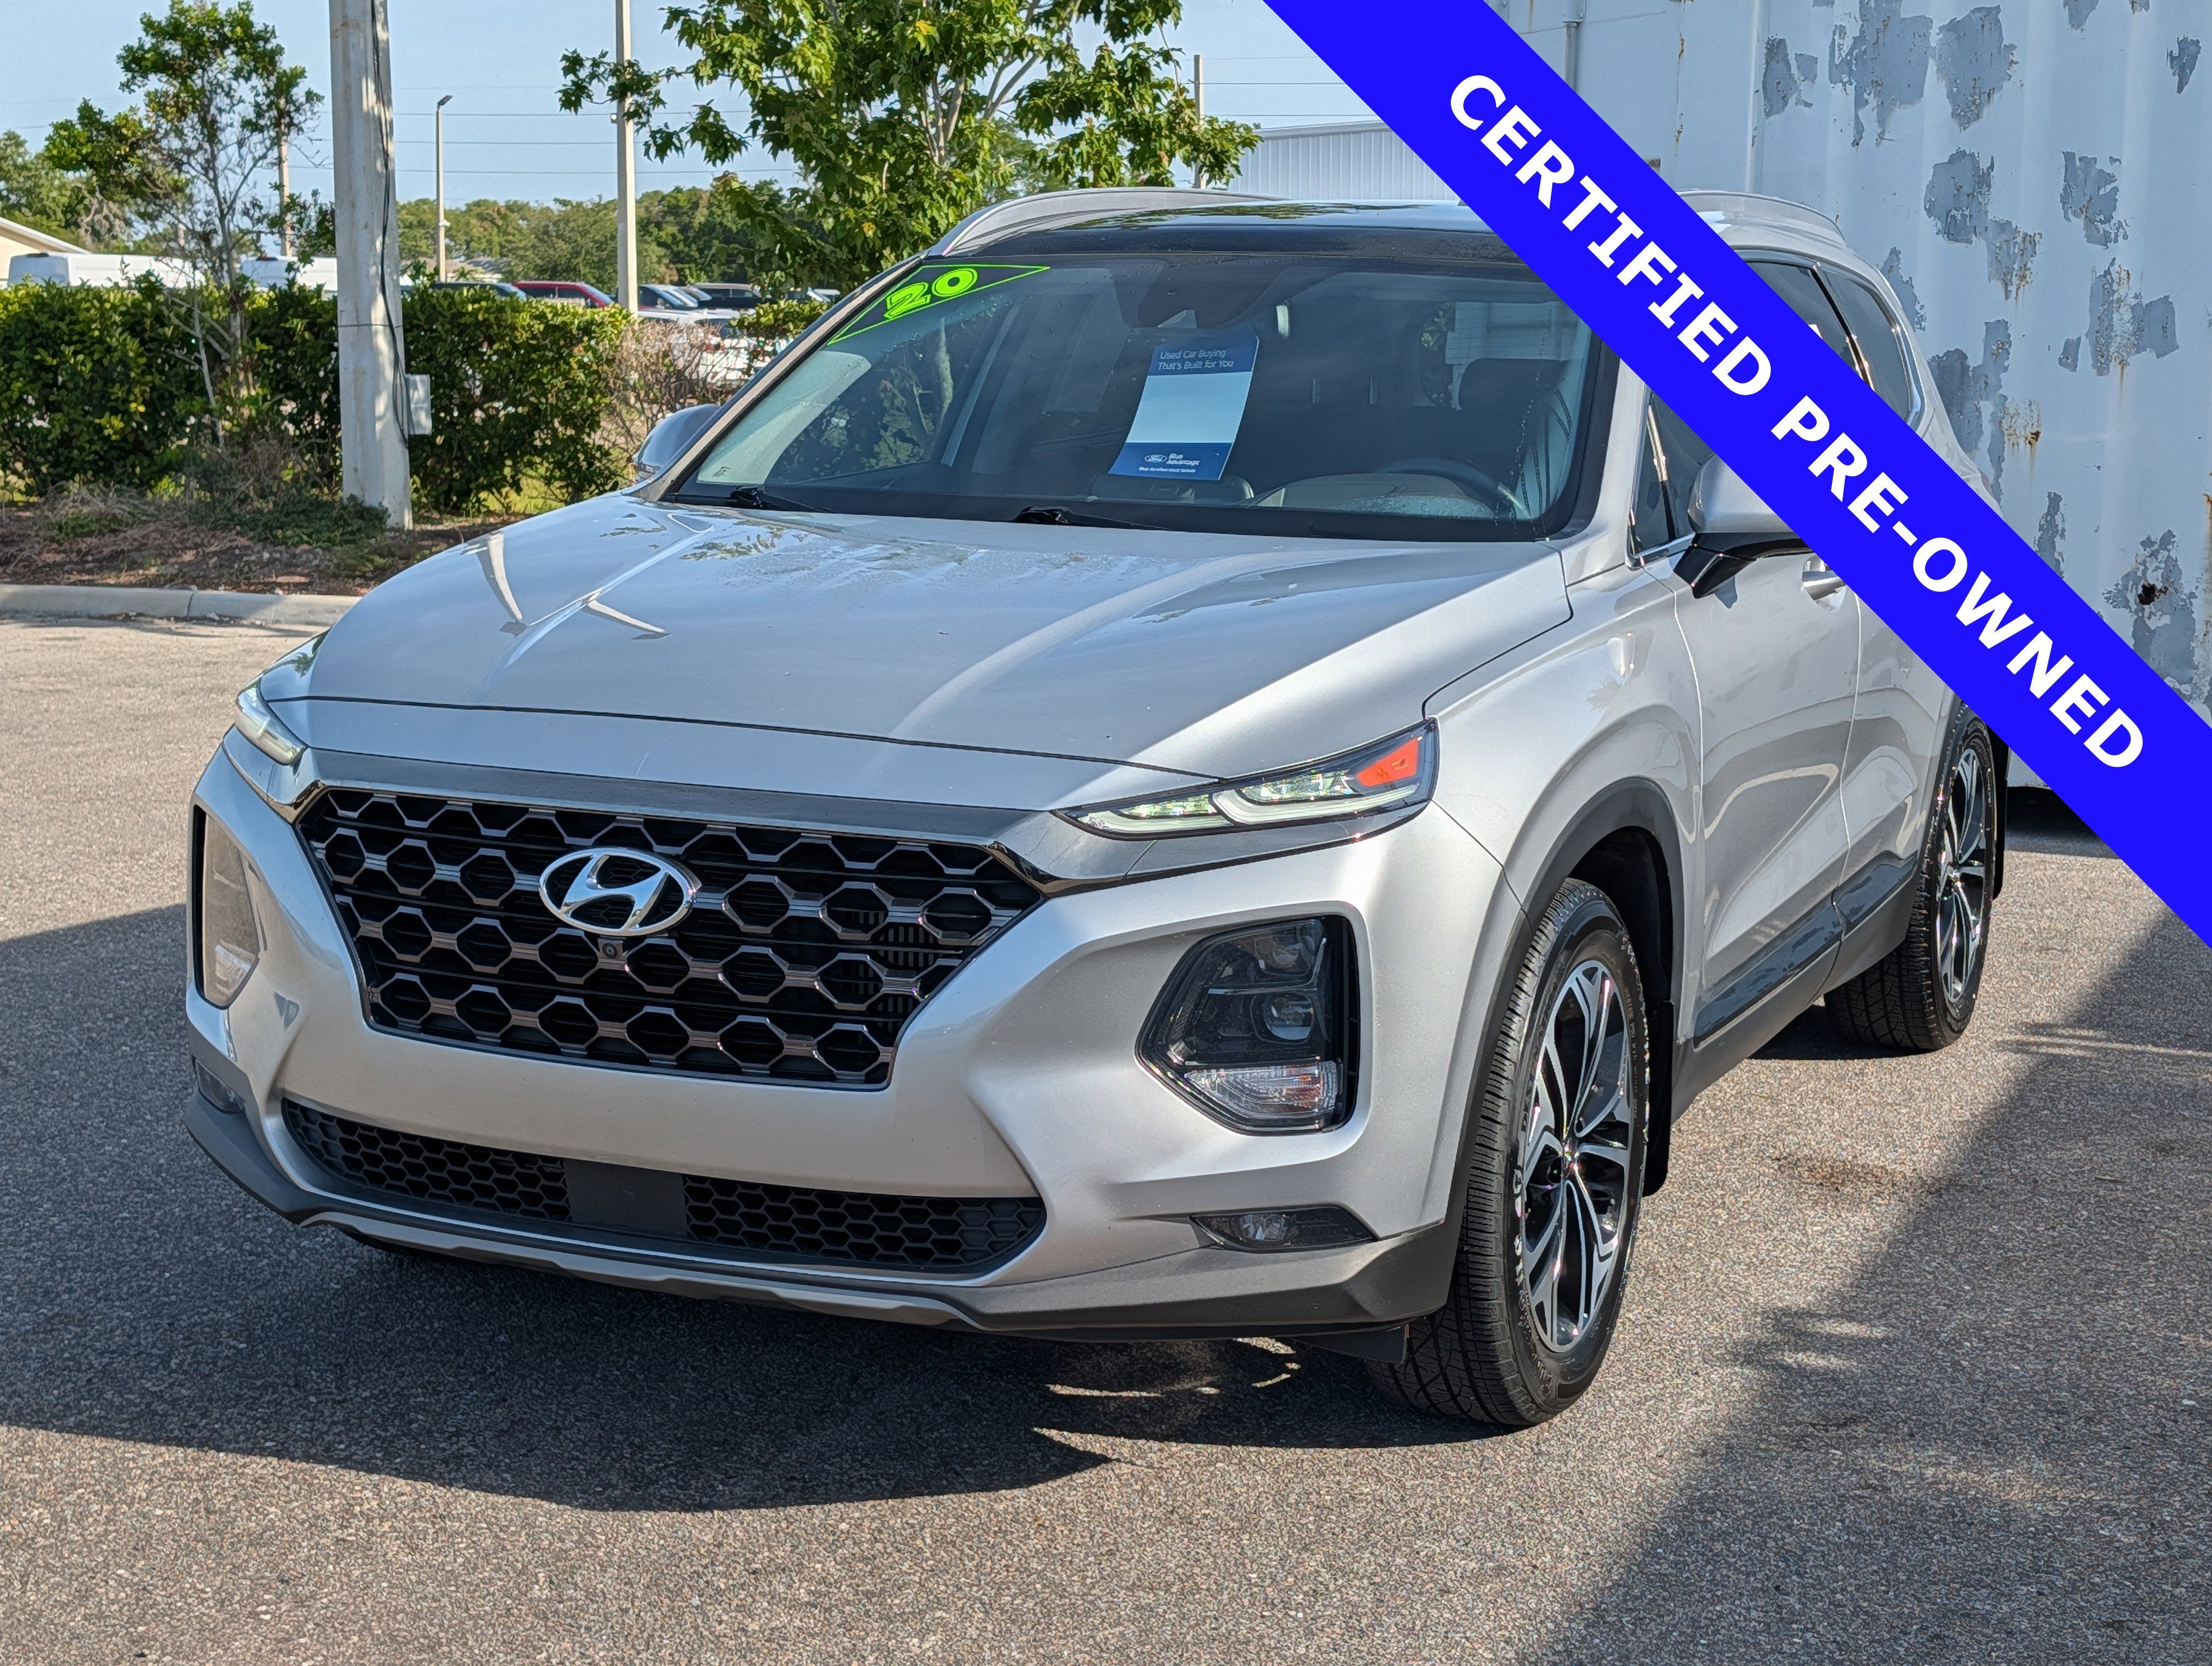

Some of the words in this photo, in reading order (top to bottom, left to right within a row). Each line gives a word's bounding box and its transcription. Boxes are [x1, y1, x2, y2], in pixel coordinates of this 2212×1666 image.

[884, 267, 978, 319] 20
[1160, 351, 1182, 359] Used
[1183, 350, 1197, 358] Car
[1198, 349, 1226, 358] Buying
[1159, 361, 1182, 370] That's
[1204, 360, 1217, 368] for
[1219, 359, 1234, 368] You
